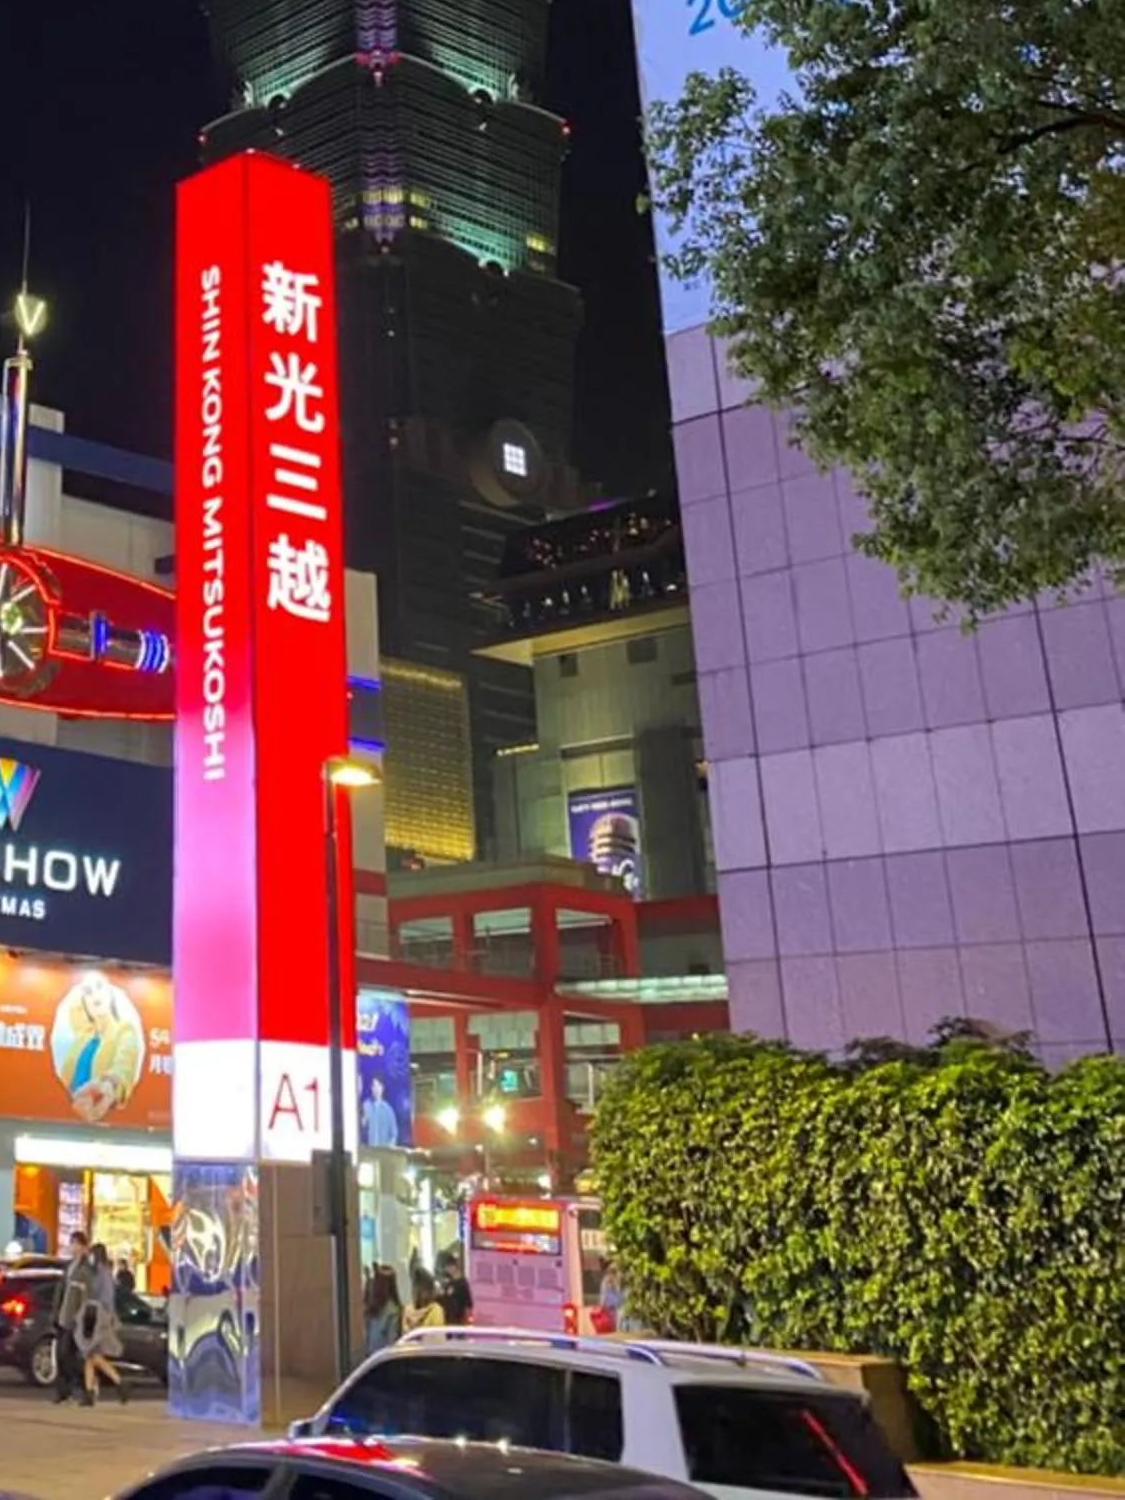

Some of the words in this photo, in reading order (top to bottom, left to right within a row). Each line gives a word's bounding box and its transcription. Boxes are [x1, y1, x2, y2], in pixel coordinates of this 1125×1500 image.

[201, 265, 221, 363] SHIN
[201, 367, 223, 489] KONG
[261, 260, 332, 623] 新光三越
[202, 496, 226, 781] MITSUKOSHI
[268, 1072, 320, 1133] A1
